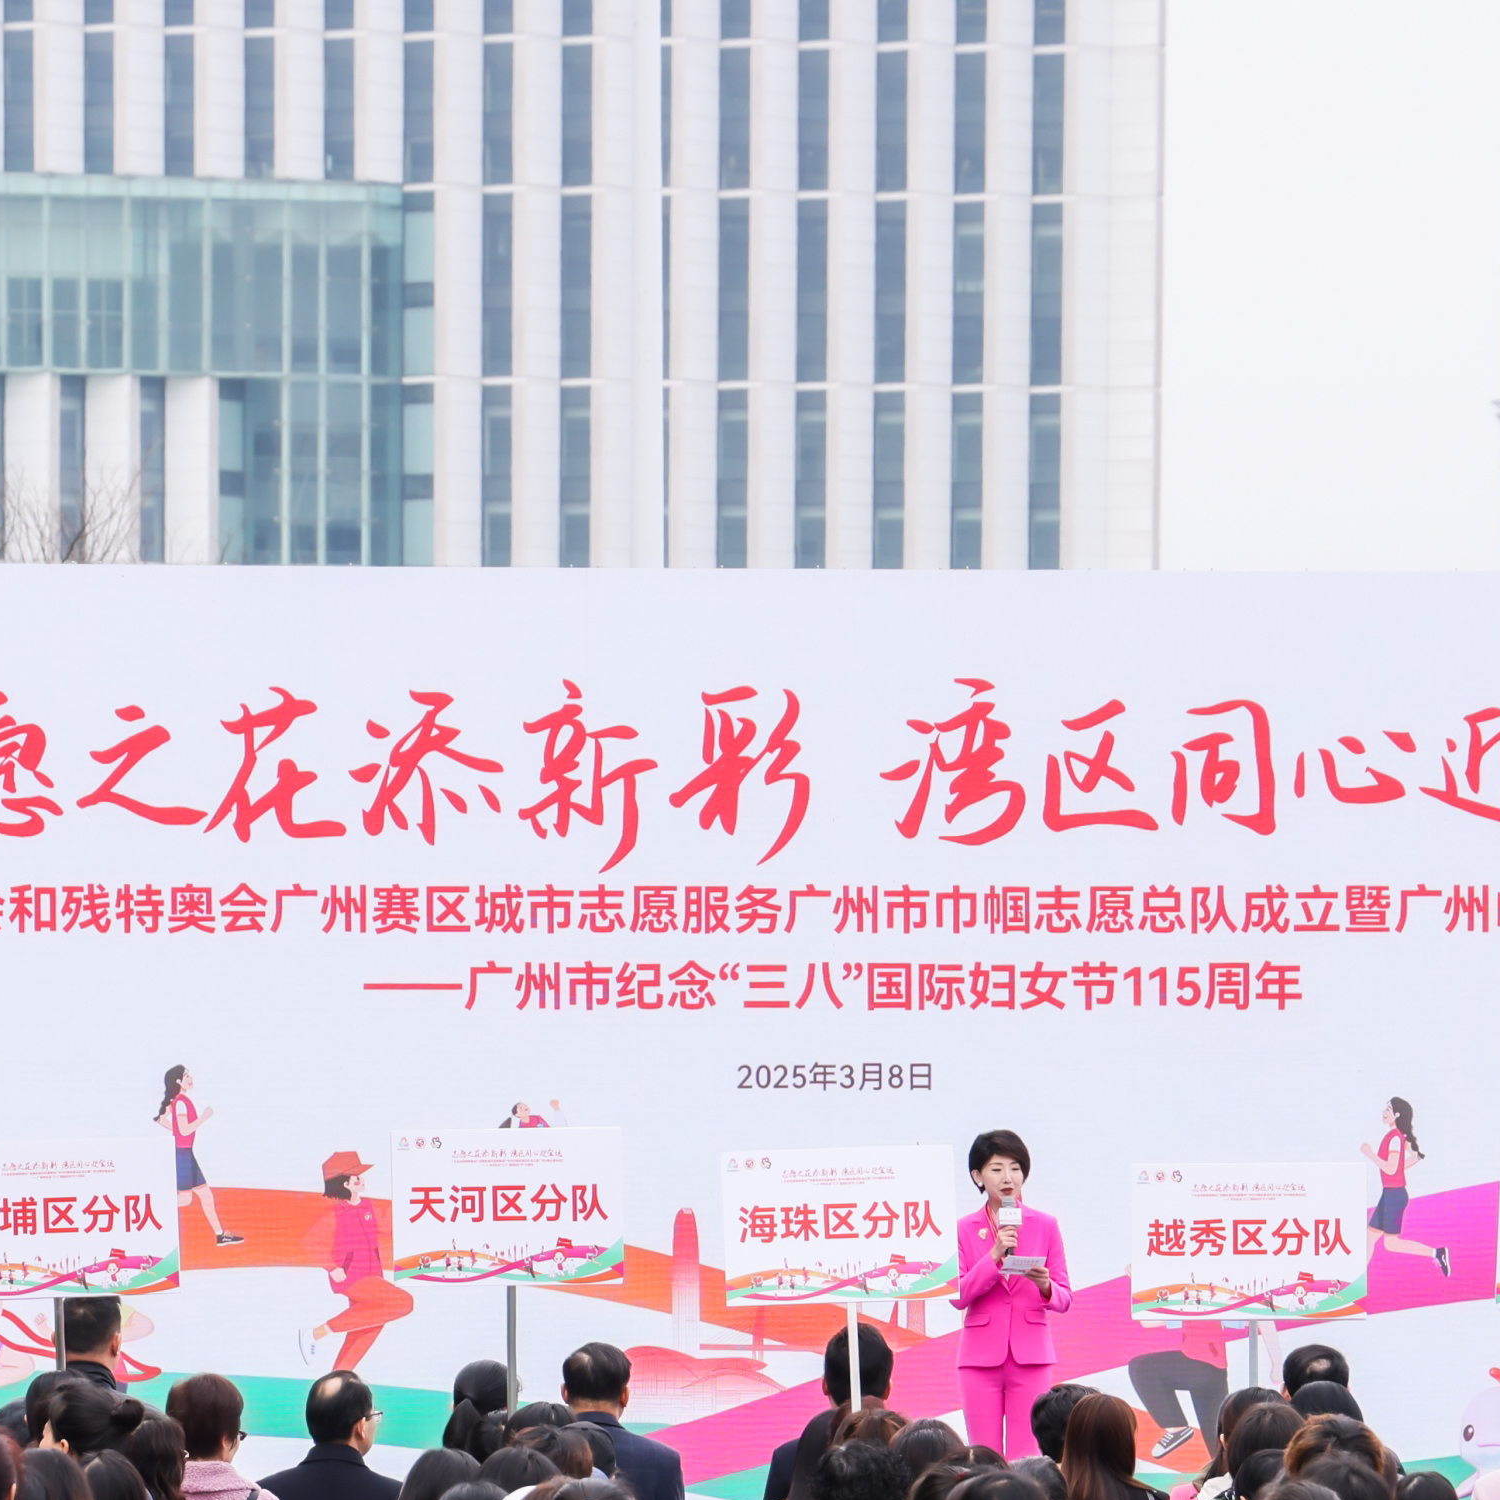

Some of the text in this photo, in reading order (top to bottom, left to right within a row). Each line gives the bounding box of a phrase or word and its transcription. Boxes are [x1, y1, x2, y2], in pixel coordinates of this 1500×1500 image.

[737, 1061, 932, 1092] 2025年3月8日
[409, 1183, 609, 1223] 天河区分队
[739, 1200, 942, 1243] 海珠区分队
[1147, 1217, 1352, 1257] 越秀区分队
